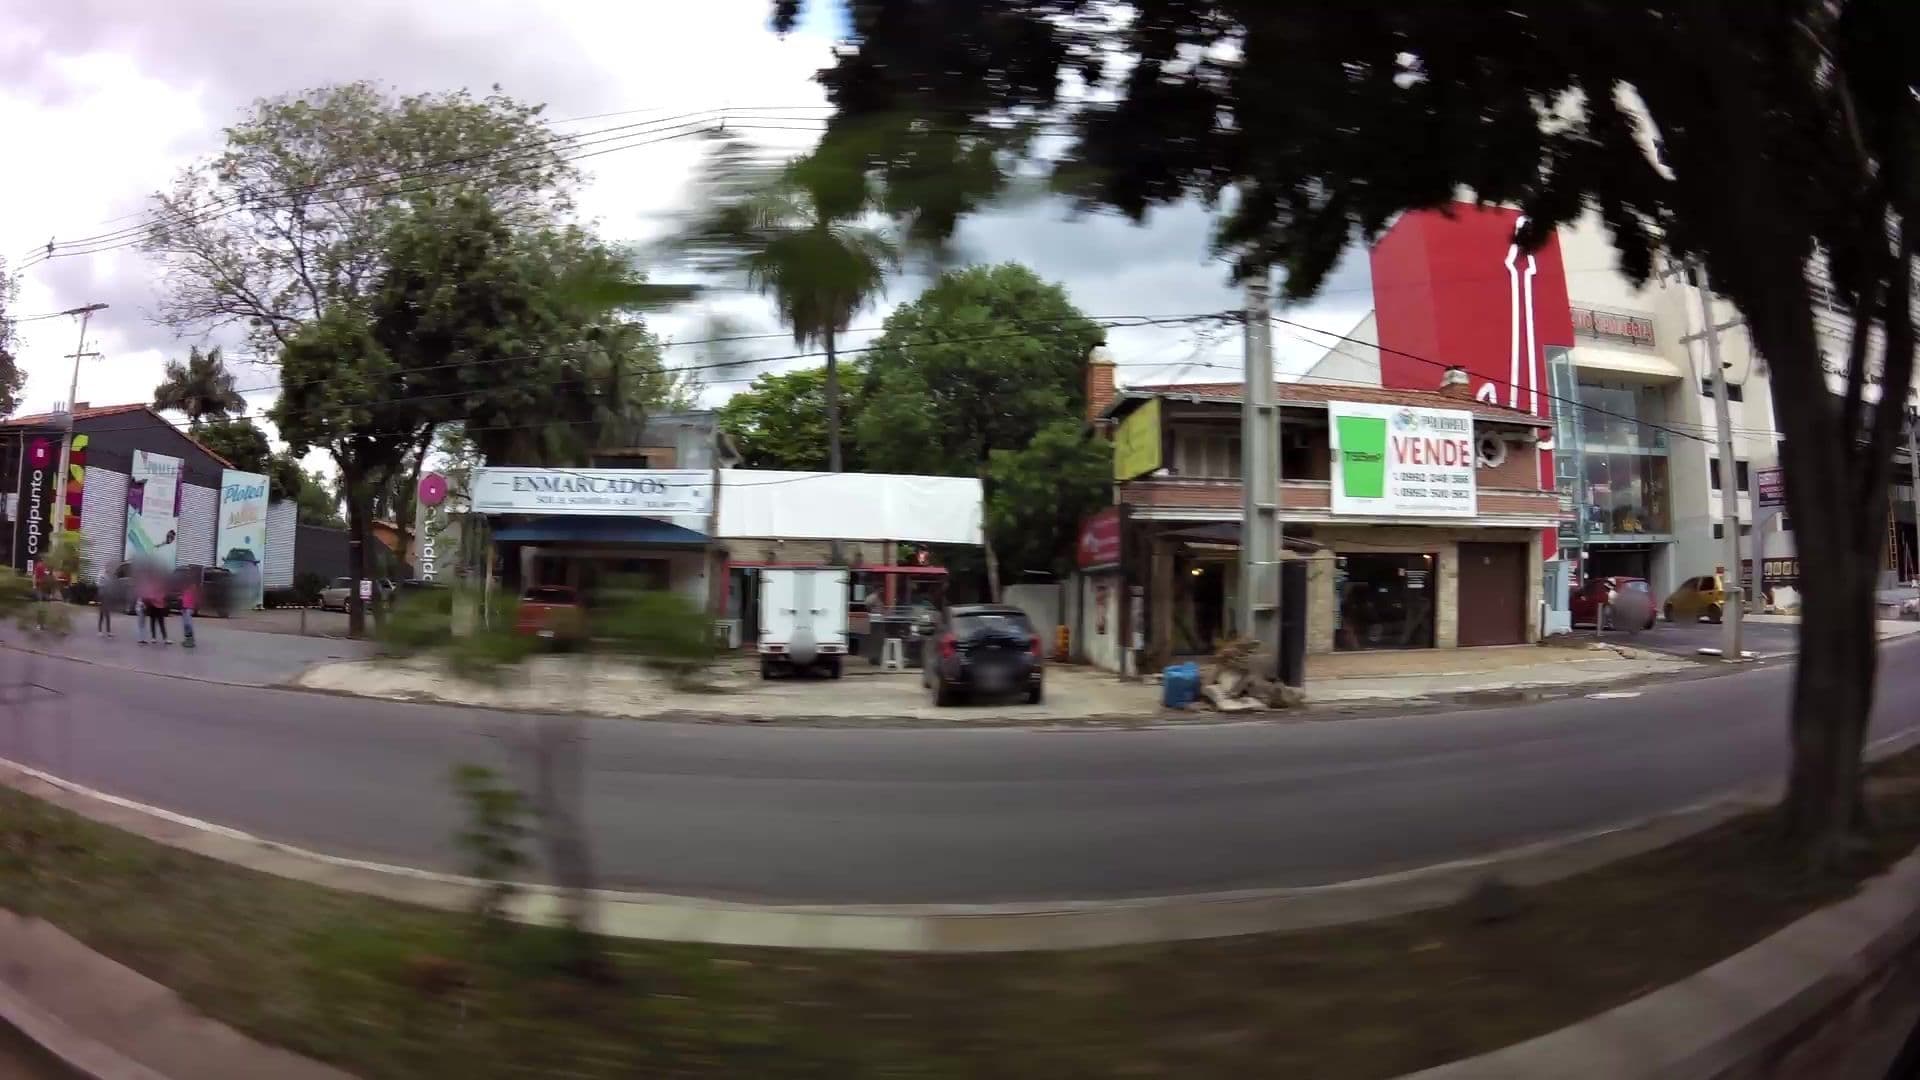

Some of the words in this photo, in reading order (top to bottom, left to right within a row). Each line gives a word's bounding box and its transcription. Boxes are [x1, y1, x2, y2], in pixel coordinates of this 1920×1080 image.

[1392, 435, 1471, 467] VENDE
[512, 476, 667, 496] ENMARCADOS
[26, 469, 43, 555] copipunto
